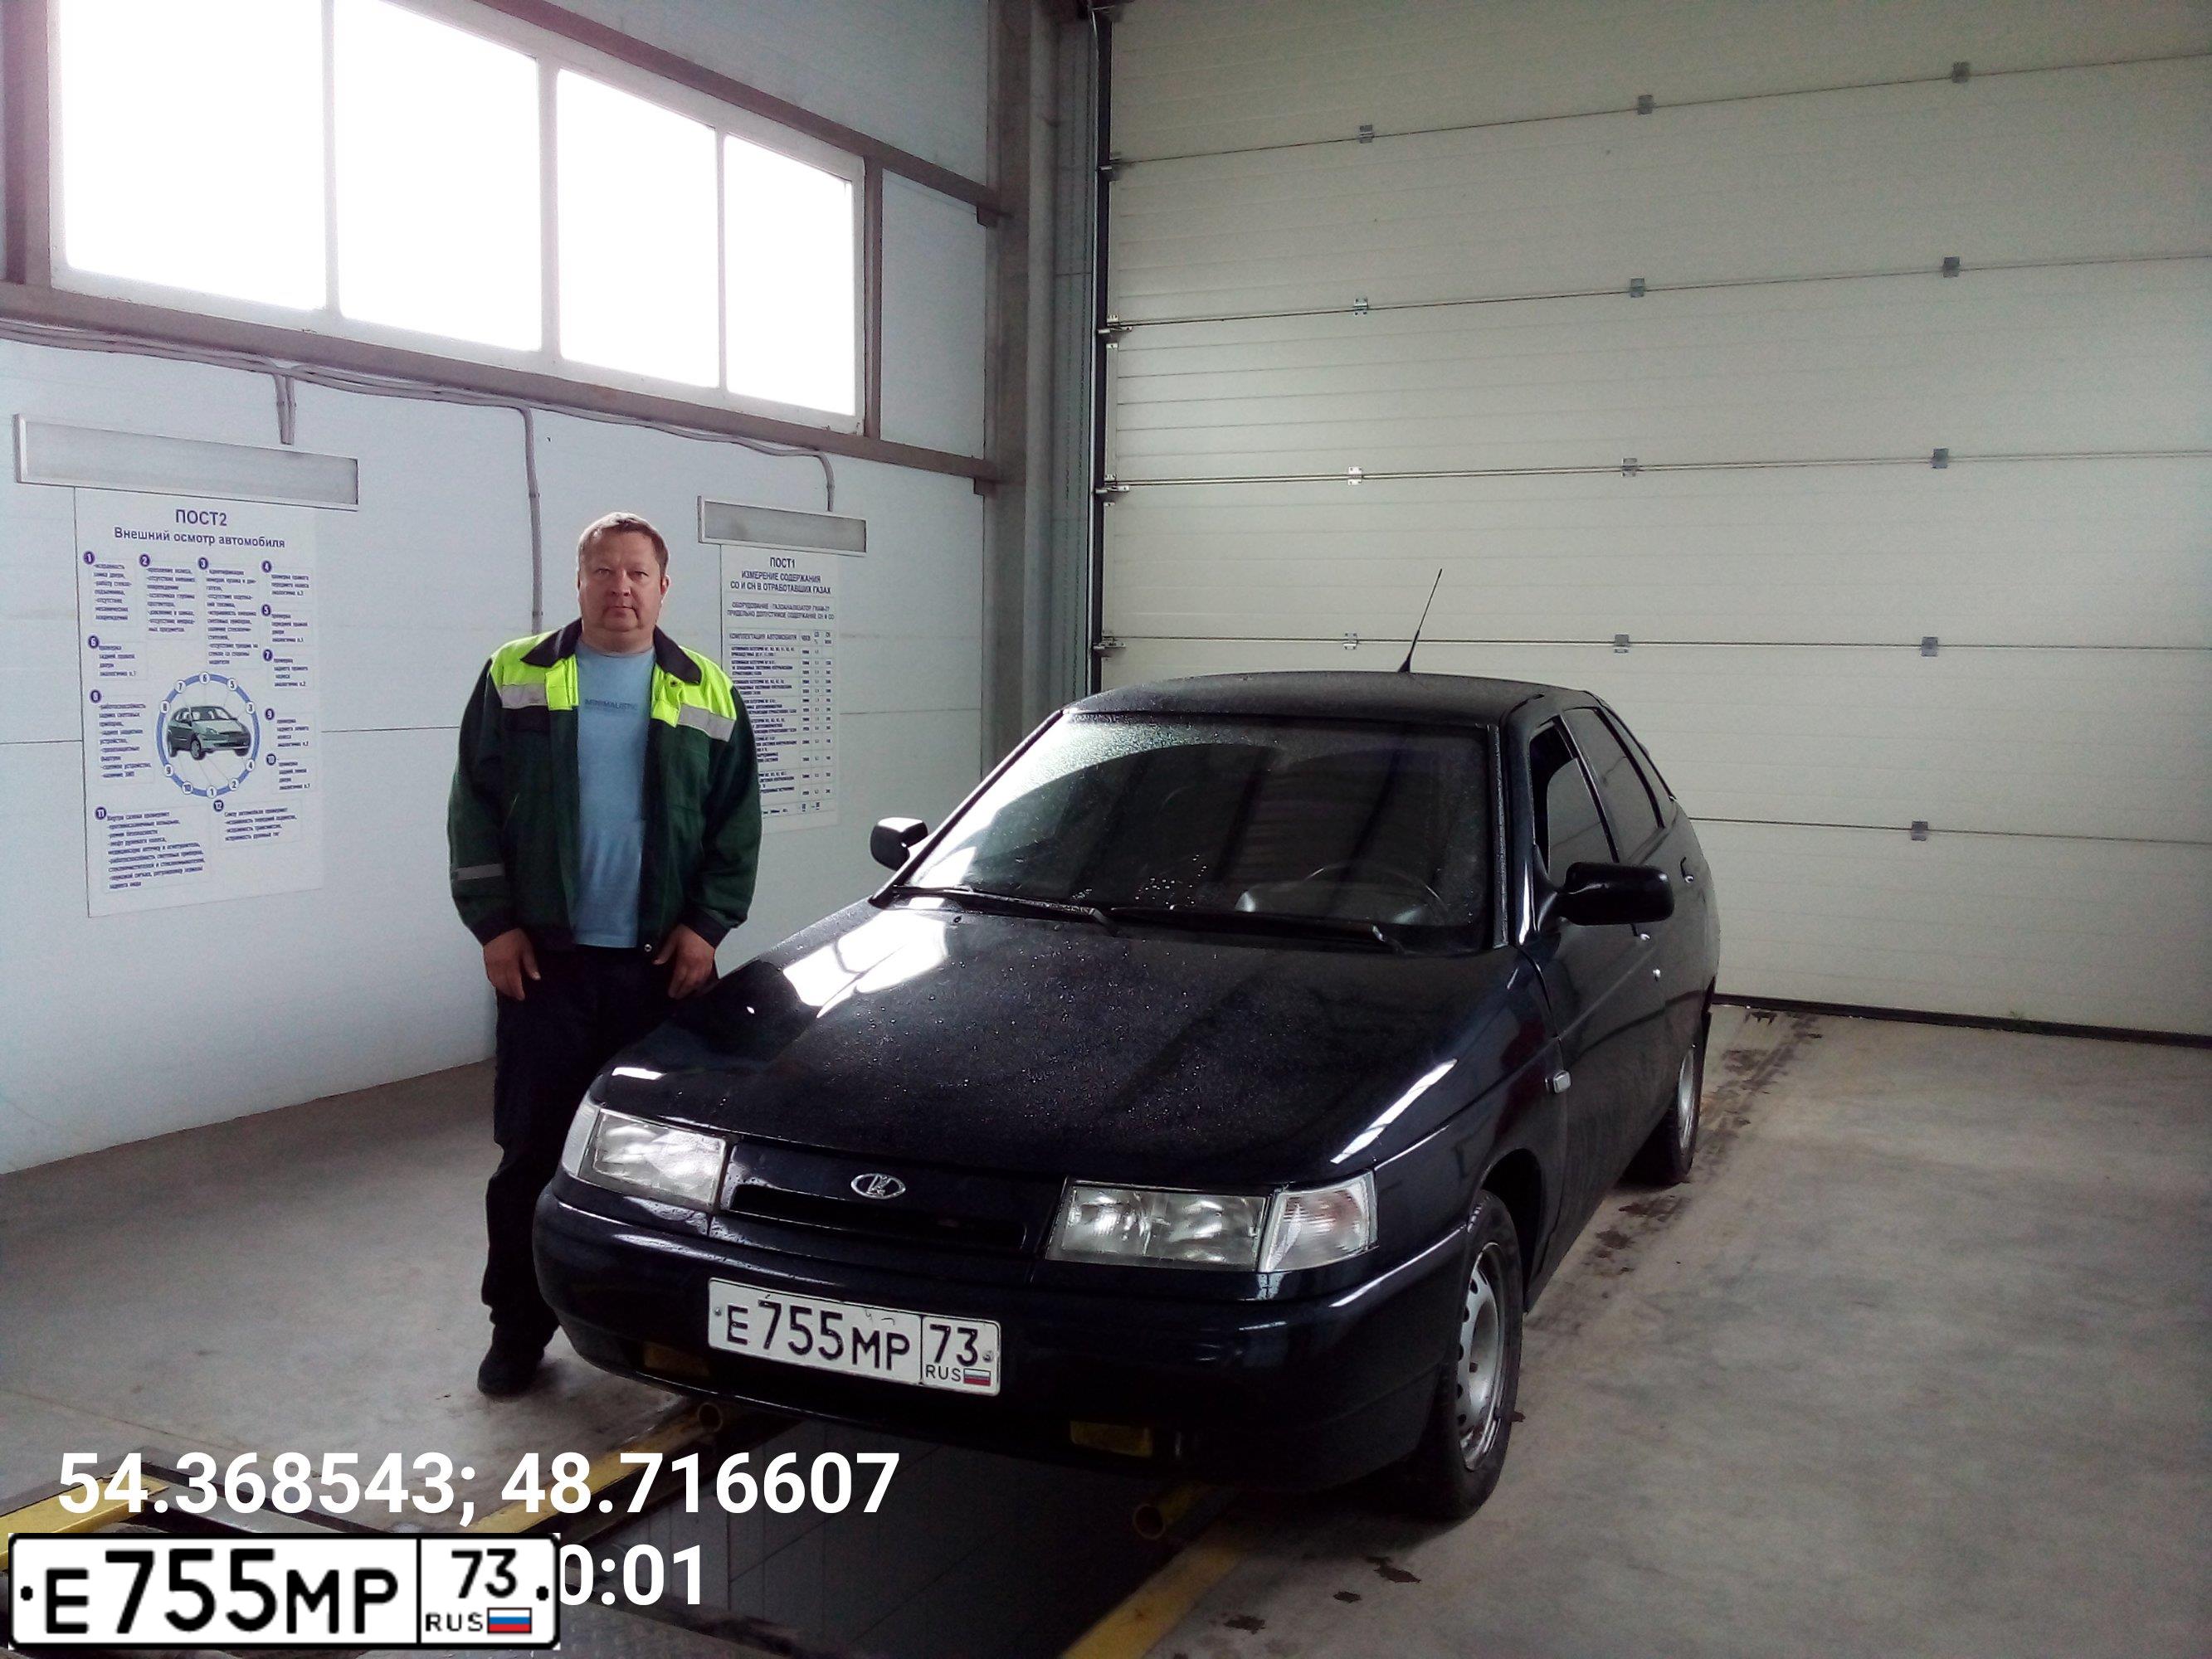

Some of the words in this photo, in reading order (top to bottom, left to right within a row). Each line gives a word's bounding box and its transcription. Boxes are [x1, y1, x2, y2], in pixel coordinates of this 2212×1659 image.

[175, 508, 227, 527] ПОСТ2
[114, 528, 170, 542] Внешний
[173, 533, 215, 547] осмотр
[218, 536, 285, 548] автомобиля
[770, 557, 796, 569] ПОСТ1
[741, 570, 779, 581] ИЗМЕРЕНИЕ
[780, 573, 821, 583] СОДЕРЖАНИЯ
[757, 582, 762, 591] В
[929, 1323, 979, 1367] 73
[925, 1364, 962, 1382] RUS
